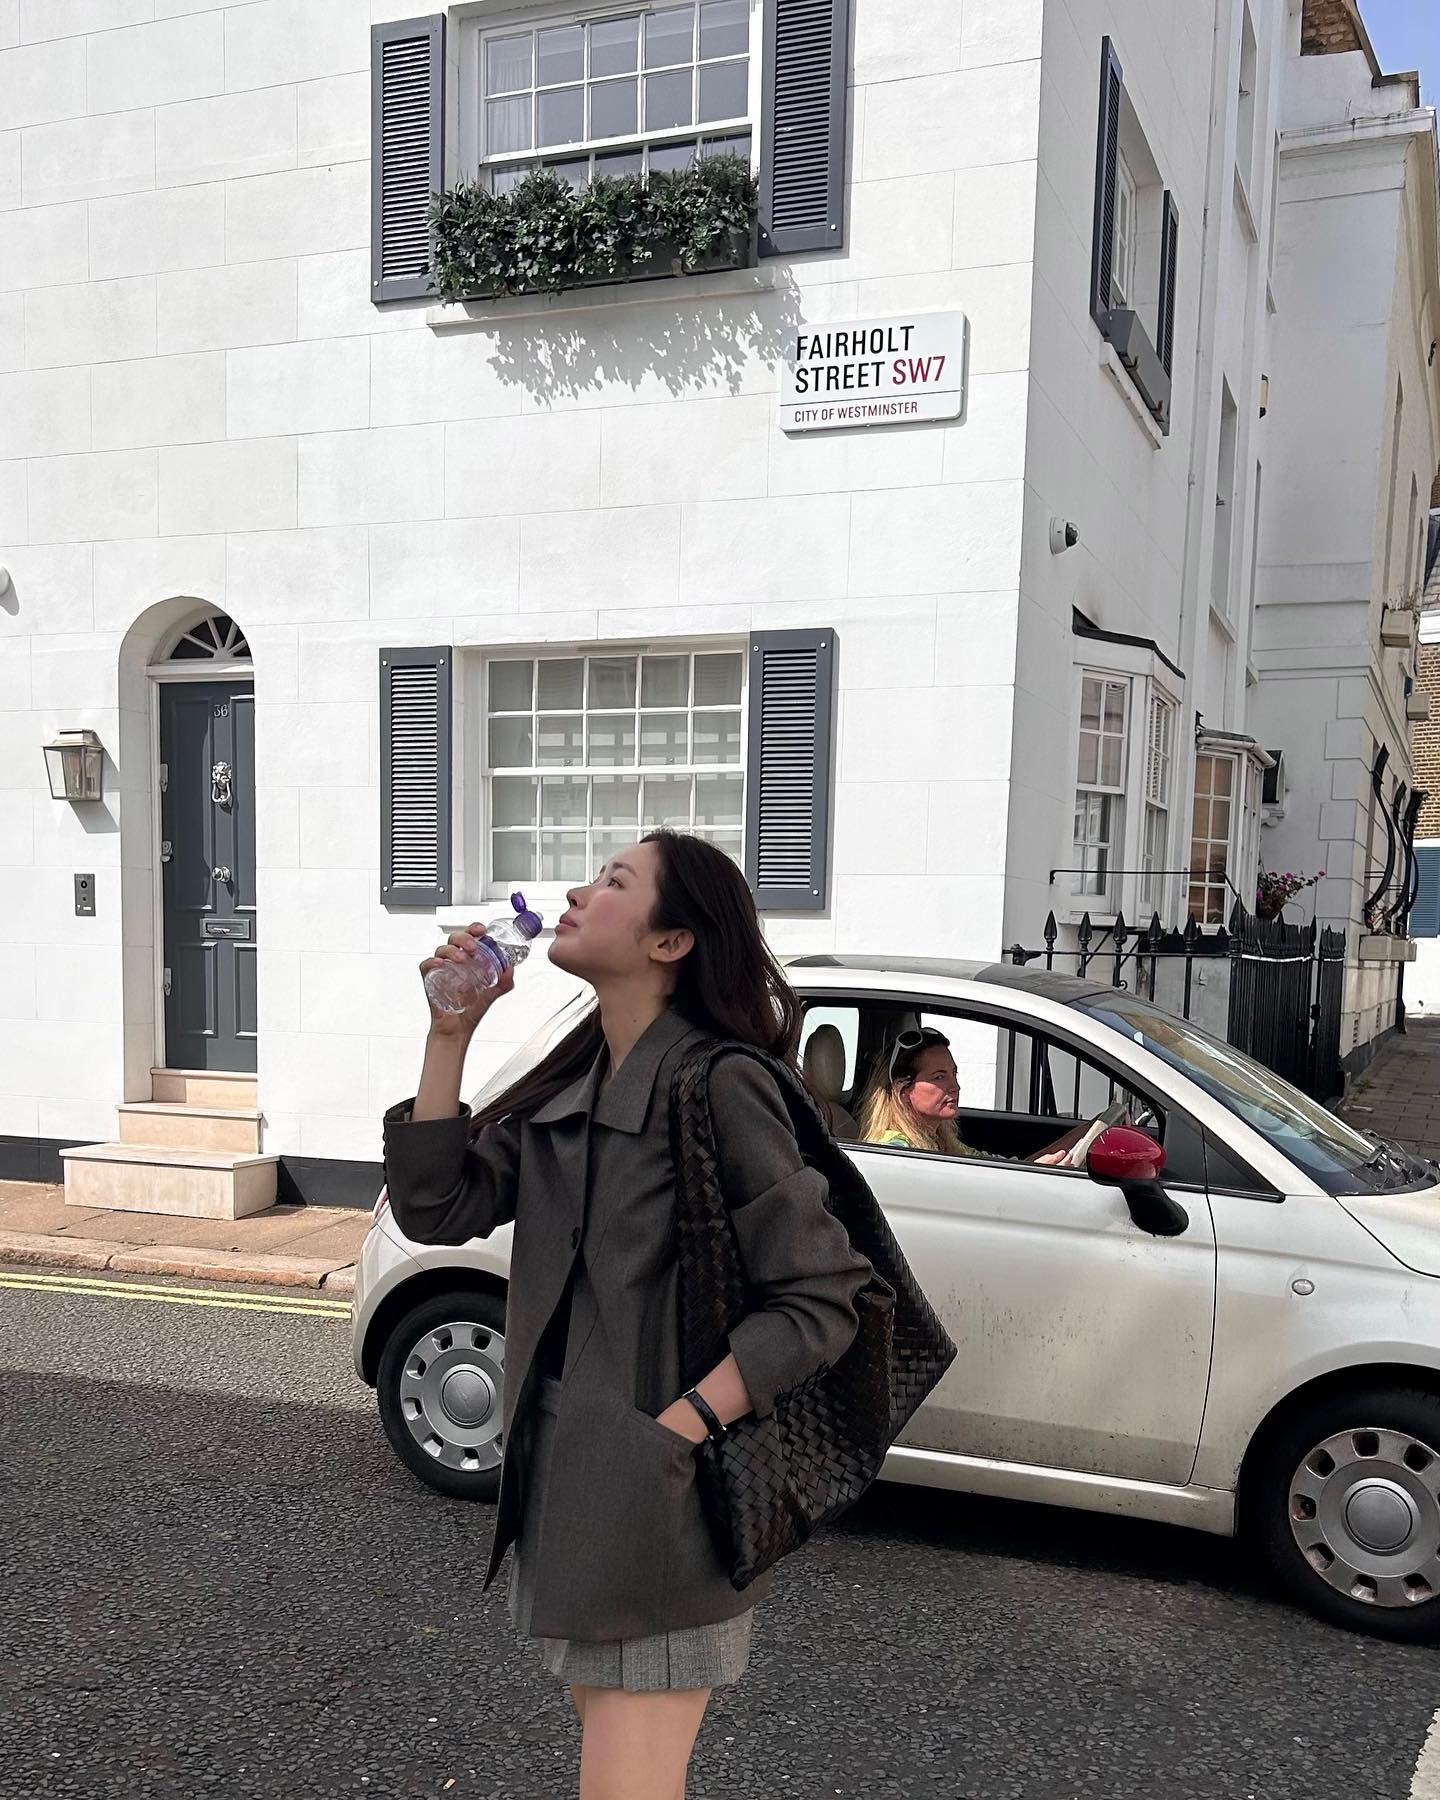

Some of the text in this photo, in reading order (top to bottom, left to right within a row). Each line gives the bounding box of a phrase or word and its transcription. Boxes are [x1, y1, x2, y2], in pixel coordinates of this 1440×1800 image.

[796, 325, 915, 361] FAIRHOLT
[795, 355, 946, 394] STREET SW7
[794, 401, 918, 423] CITY OF WESTMINSTER
[213, 704, 228, 717] 36
